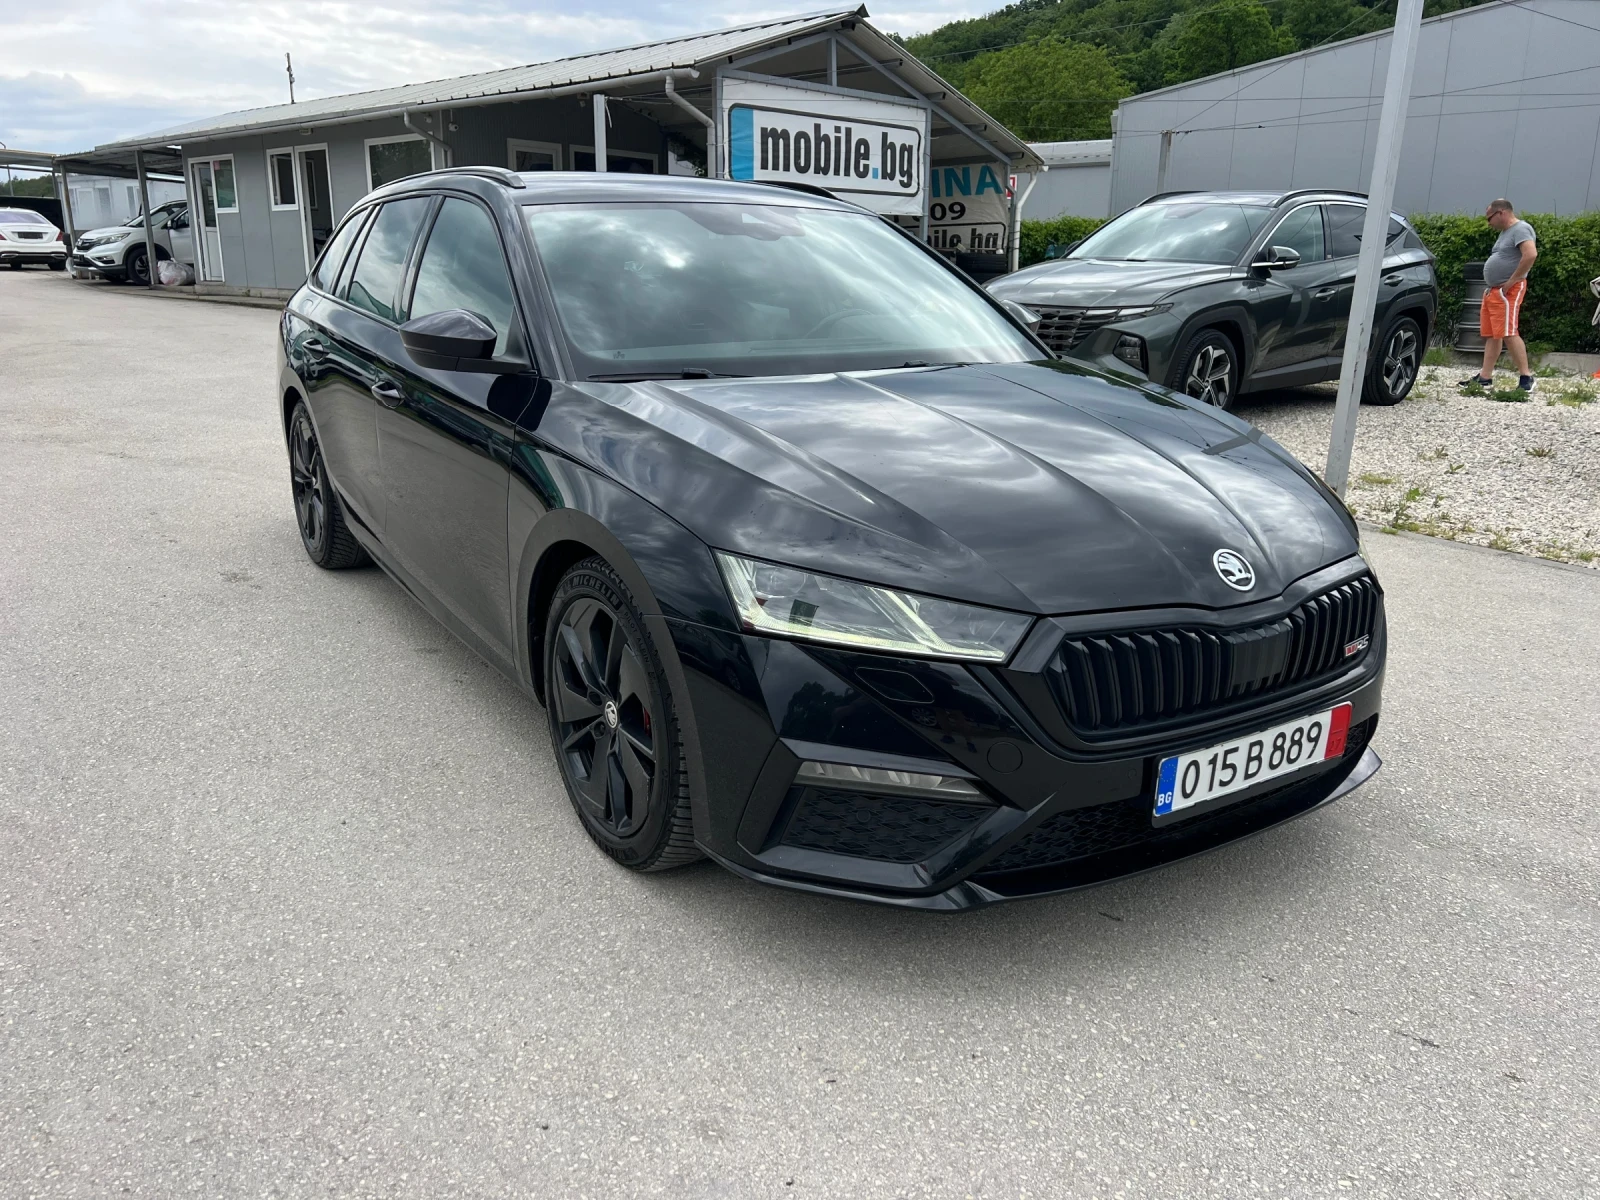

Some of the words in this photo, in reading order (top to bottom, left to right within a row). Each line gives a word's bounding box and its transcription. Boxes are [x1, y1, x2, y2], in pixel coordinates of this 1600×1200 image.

[760, 123, 913, 188] mobile.bg
[931, 164, 1003, 197] INA
[572, 575, 620, 607] MICHELIN
[1157, 791, 1172, 806] BG
